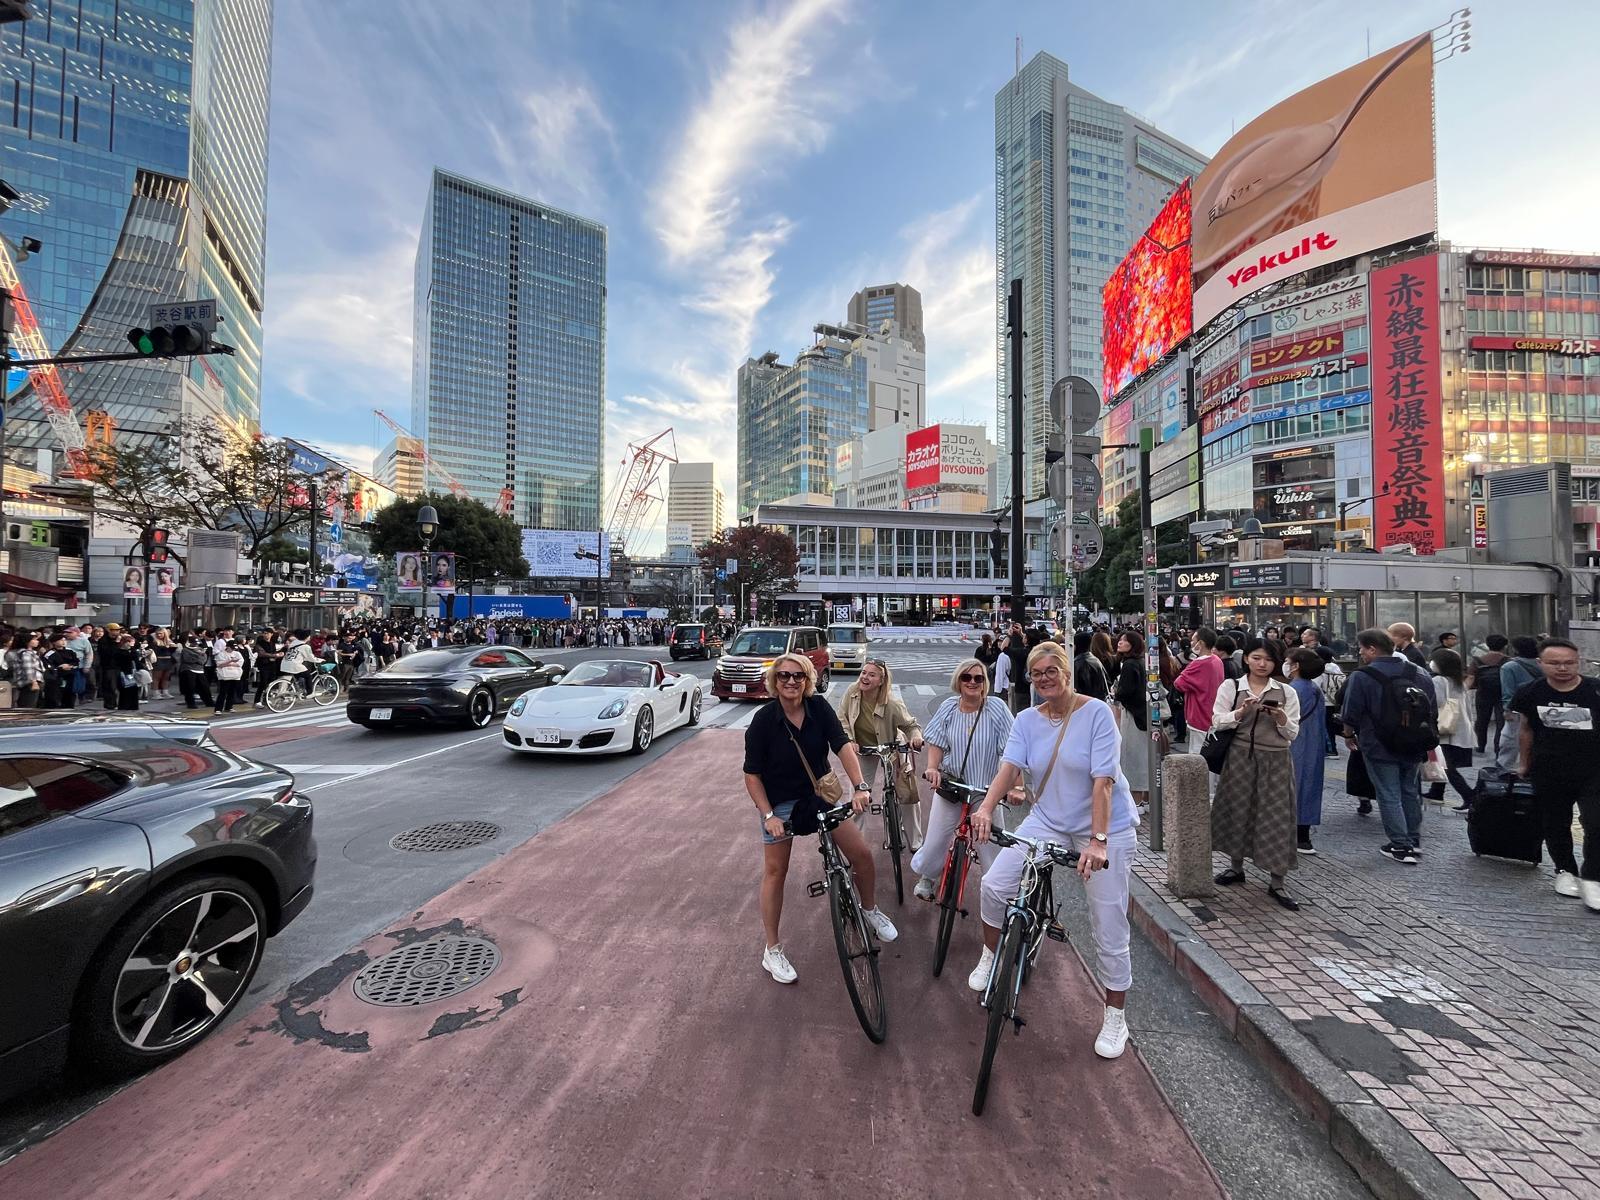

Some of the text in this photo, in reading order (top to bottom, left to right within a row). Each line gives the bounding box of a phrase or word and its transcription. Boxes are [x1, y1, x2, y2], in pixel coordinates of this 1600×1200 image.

[1226, 232, 1338, 288] Yakult
[1261, 276, 1360, 311] しゃぶしゃぶバイキング
[155, 304, 211, 322] 渋谷駅前
[1303, 292, 1364, 321] しゃぶ葉
[1252, 336, 1341, 367] コンタクト
[1561, 340, 1597, 354] ガスト
[1311, 357, 1356, 378] ガスト
[1384, 273, 1432, 529] 赤線最狂爆音祭典
[1213, 405, 1238, 429] ガスト
[941, 434, 975, 445] ココロの
[907, 443, 939, 463] カラオケ
[907, 456, 939, 473] JOYSOUND
[941, 464, 985, 476] JOYSOUND
[1273, 491, 1314, 504] Ushi8
[490, 607, 523, 618] indeed
